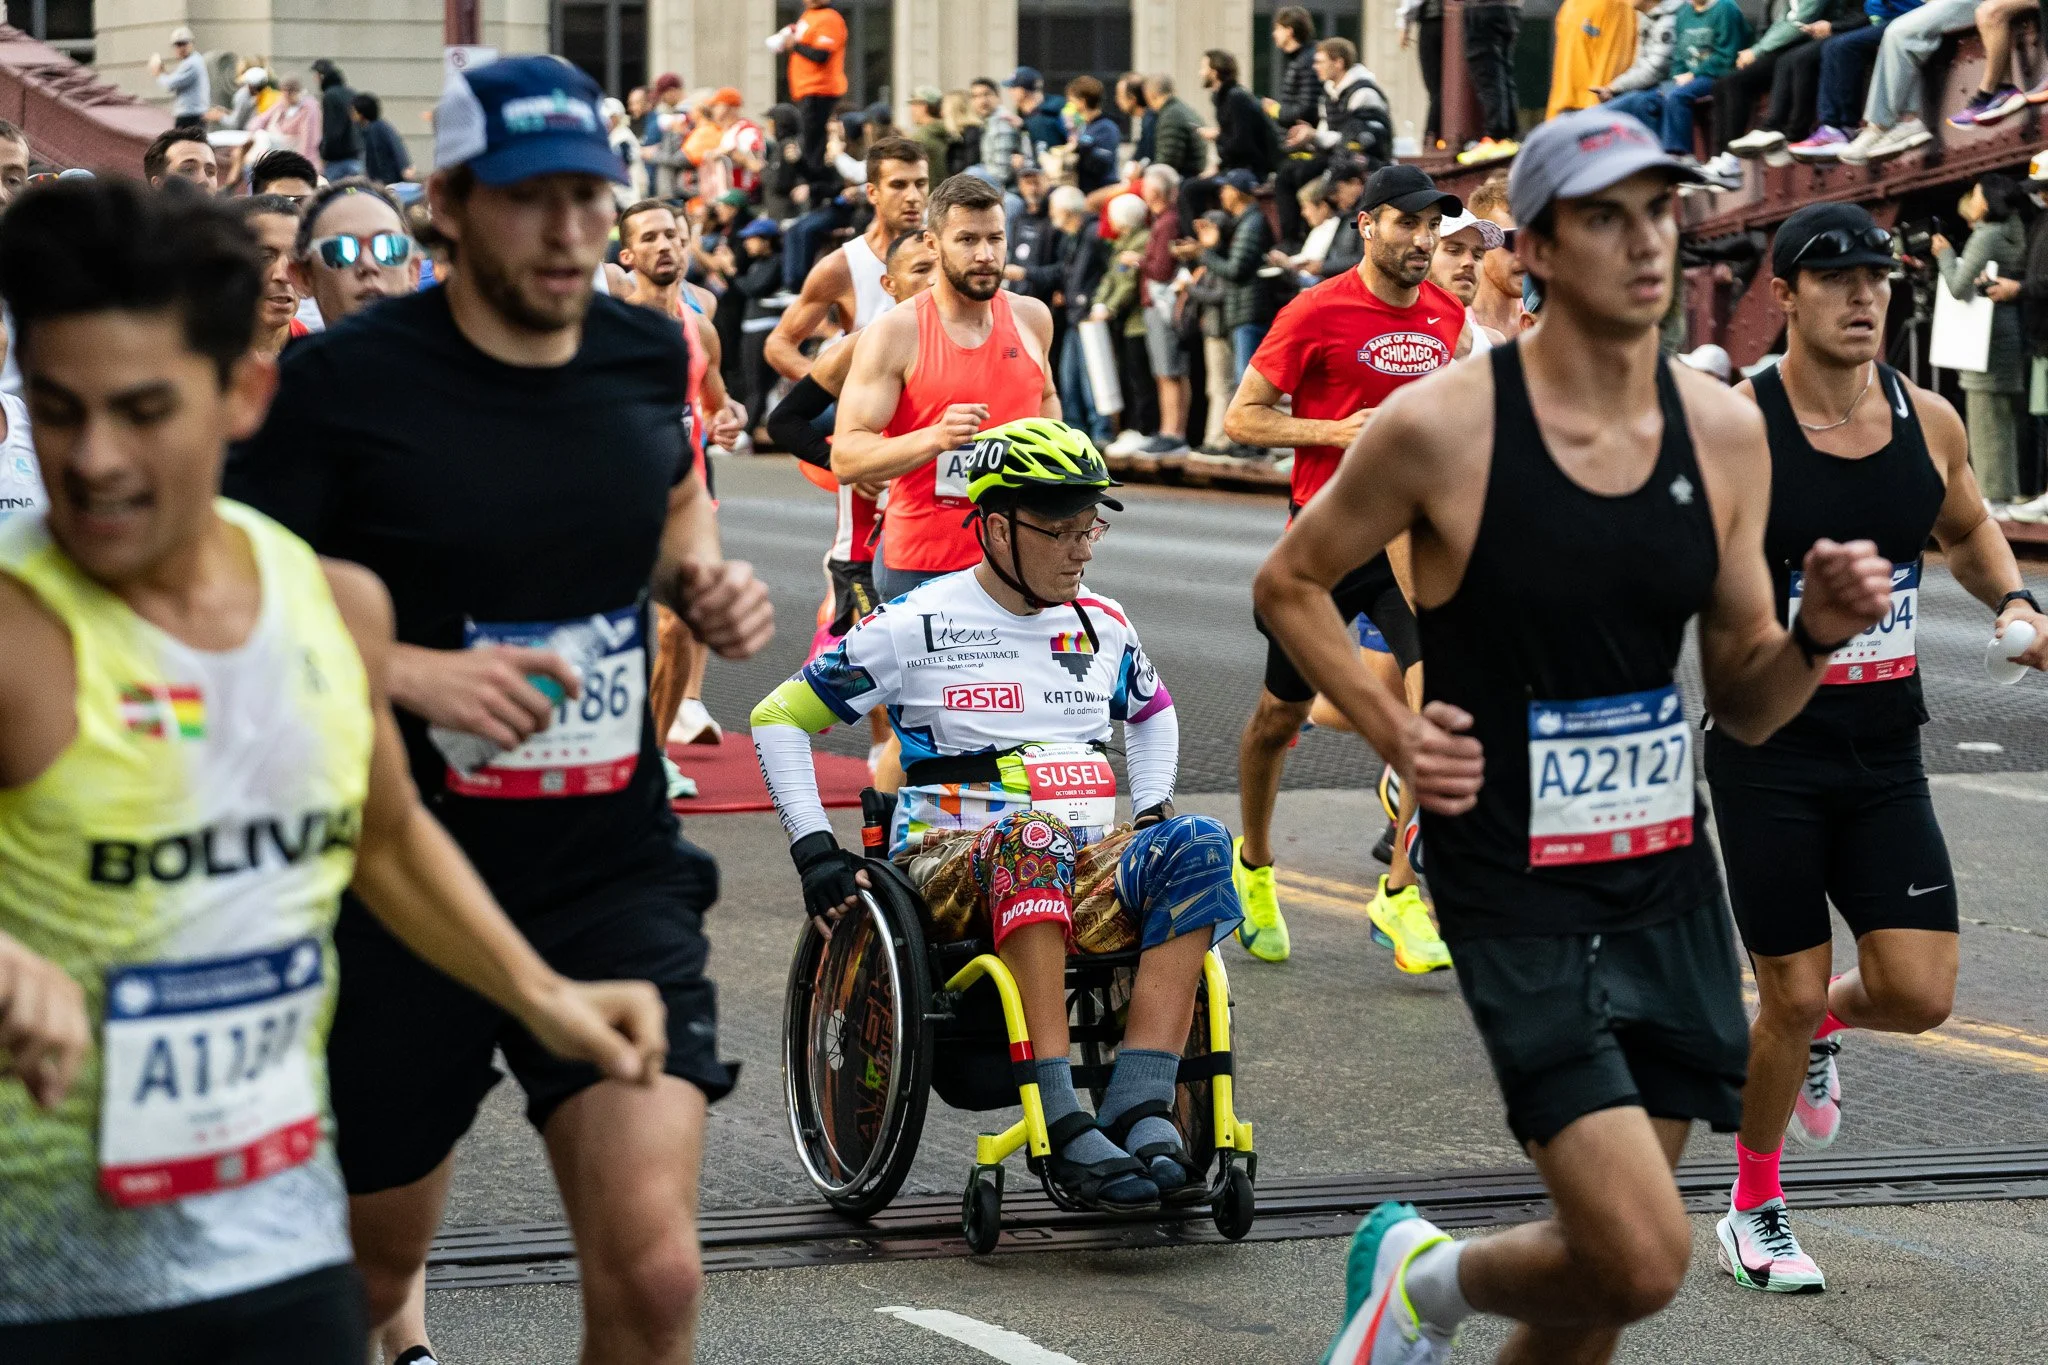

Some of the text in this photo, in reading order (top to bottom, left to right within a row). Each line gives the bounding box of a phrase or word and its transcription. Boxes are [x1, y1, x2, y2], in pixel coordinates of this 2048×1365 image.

[1368, 335, 1442, 351] BANK OF AMERICA
[1380, 344, 1433, 362] CHICAGO
[1374, 355, 1439, 373] MARATHON
[907, 650, 1020, 668] HOTELE & RESTAURACJE
[947, 685, 1021, 709] rastal
[1043, 690, 1110, 704] KATOWI
[1063, 707, 1075, 715] dla
[1035, 764, 1110, 787] SUSEL
[1538, 734, 1686, 799] A22127
[1055, 789, 1077, 797] OCTOBER
